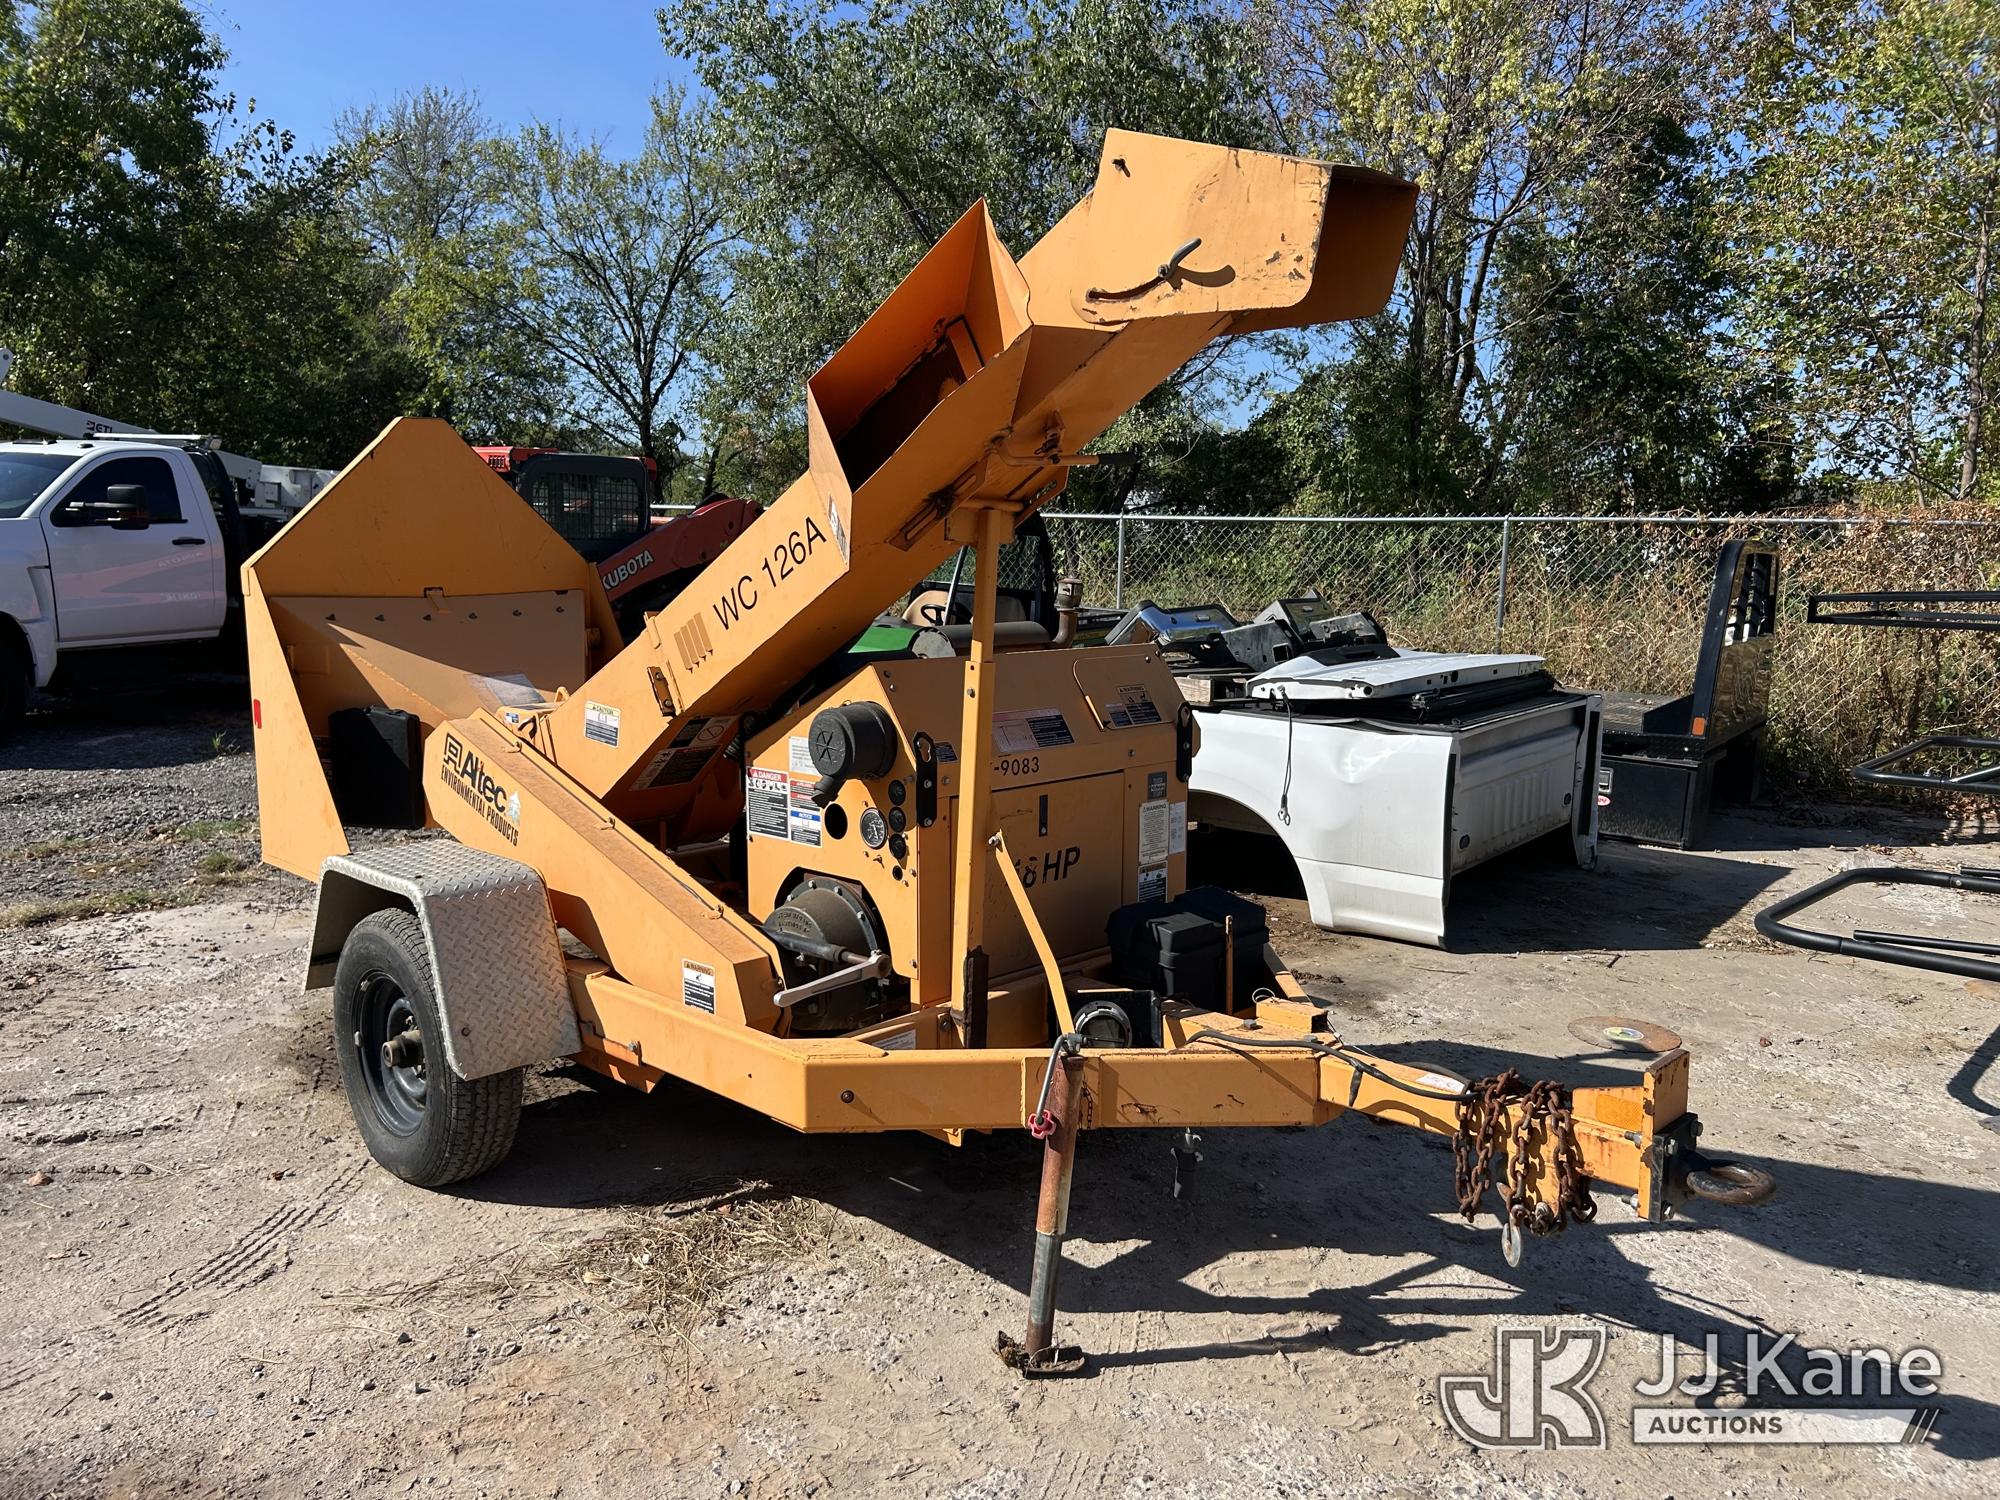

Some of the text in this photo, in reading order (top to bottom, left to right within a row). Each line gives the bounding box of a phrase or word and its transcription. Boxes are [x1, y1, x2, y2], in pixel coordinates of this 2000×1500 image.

[712, 575, 758, 631] WC
[761, 516, 827, 588] 126A
[460, 750, 507, 813] Altec
[758, 771, 782, 782] DANGER
[990, 756, 1040, 777] -9083
[440, 764, 519, 847] ENVIRONMENTAL PRODUCTS
[1042, 847, 1081, 883] HP
